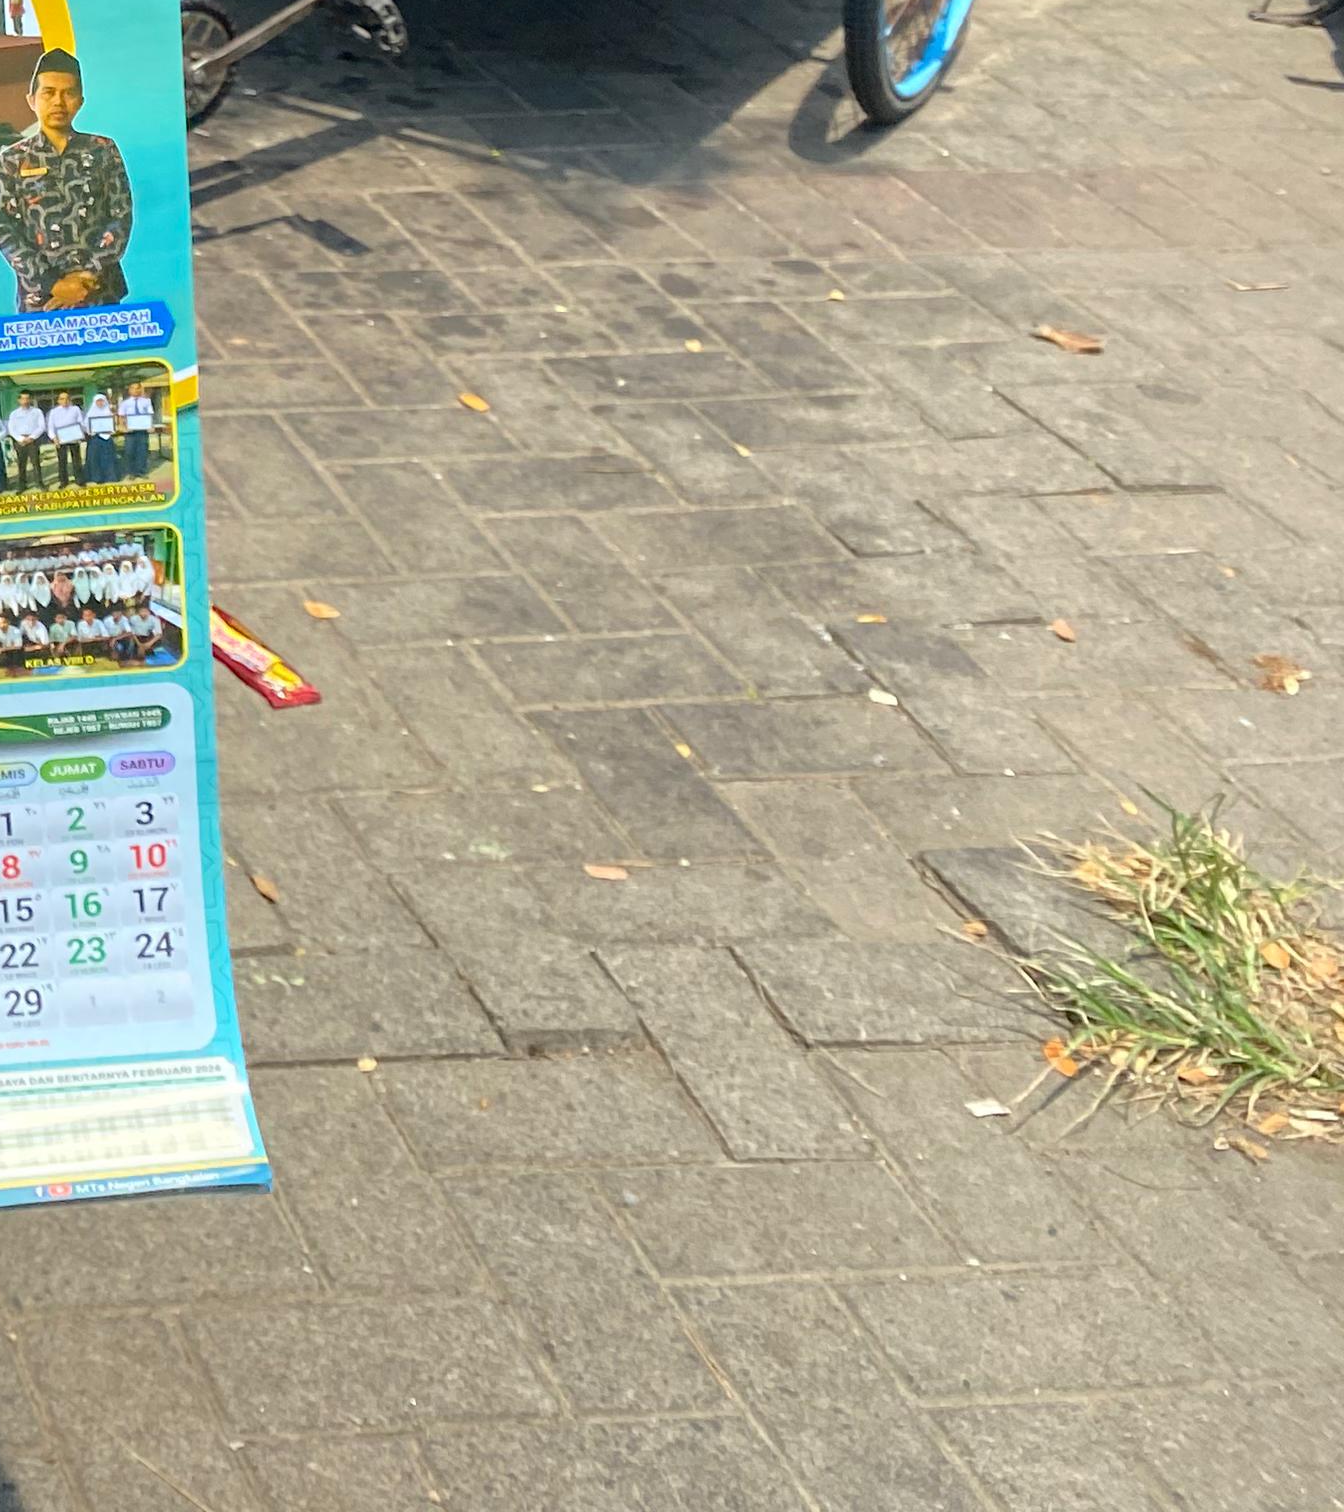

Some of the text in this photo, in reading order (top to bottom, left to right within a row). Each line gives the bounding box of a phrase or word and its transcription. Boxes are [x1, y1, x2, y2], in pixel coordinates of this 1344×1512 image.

[6, 311, 149, 334] KEPALA MADRASAH
[19, 333, 82, 347] RUSTAM,
[49, 762, 96, 777] JUMAT
[120, 758, 165, 771] SABTU
[1, 801, 154, 836] 1 2 3
[2, 855, 20, 879] 8
[69, 849, 88, 874] 9
[131, 844, 167, 868] 10
[65, 892, 102, 919] 16
[133, 887, 169, 913] 17
[0, 942, 39, 969] 22
[67, 936, 106, 965] 23
[135, 932, 174, 959] 24
[5, 988, 42, 1017] 29
